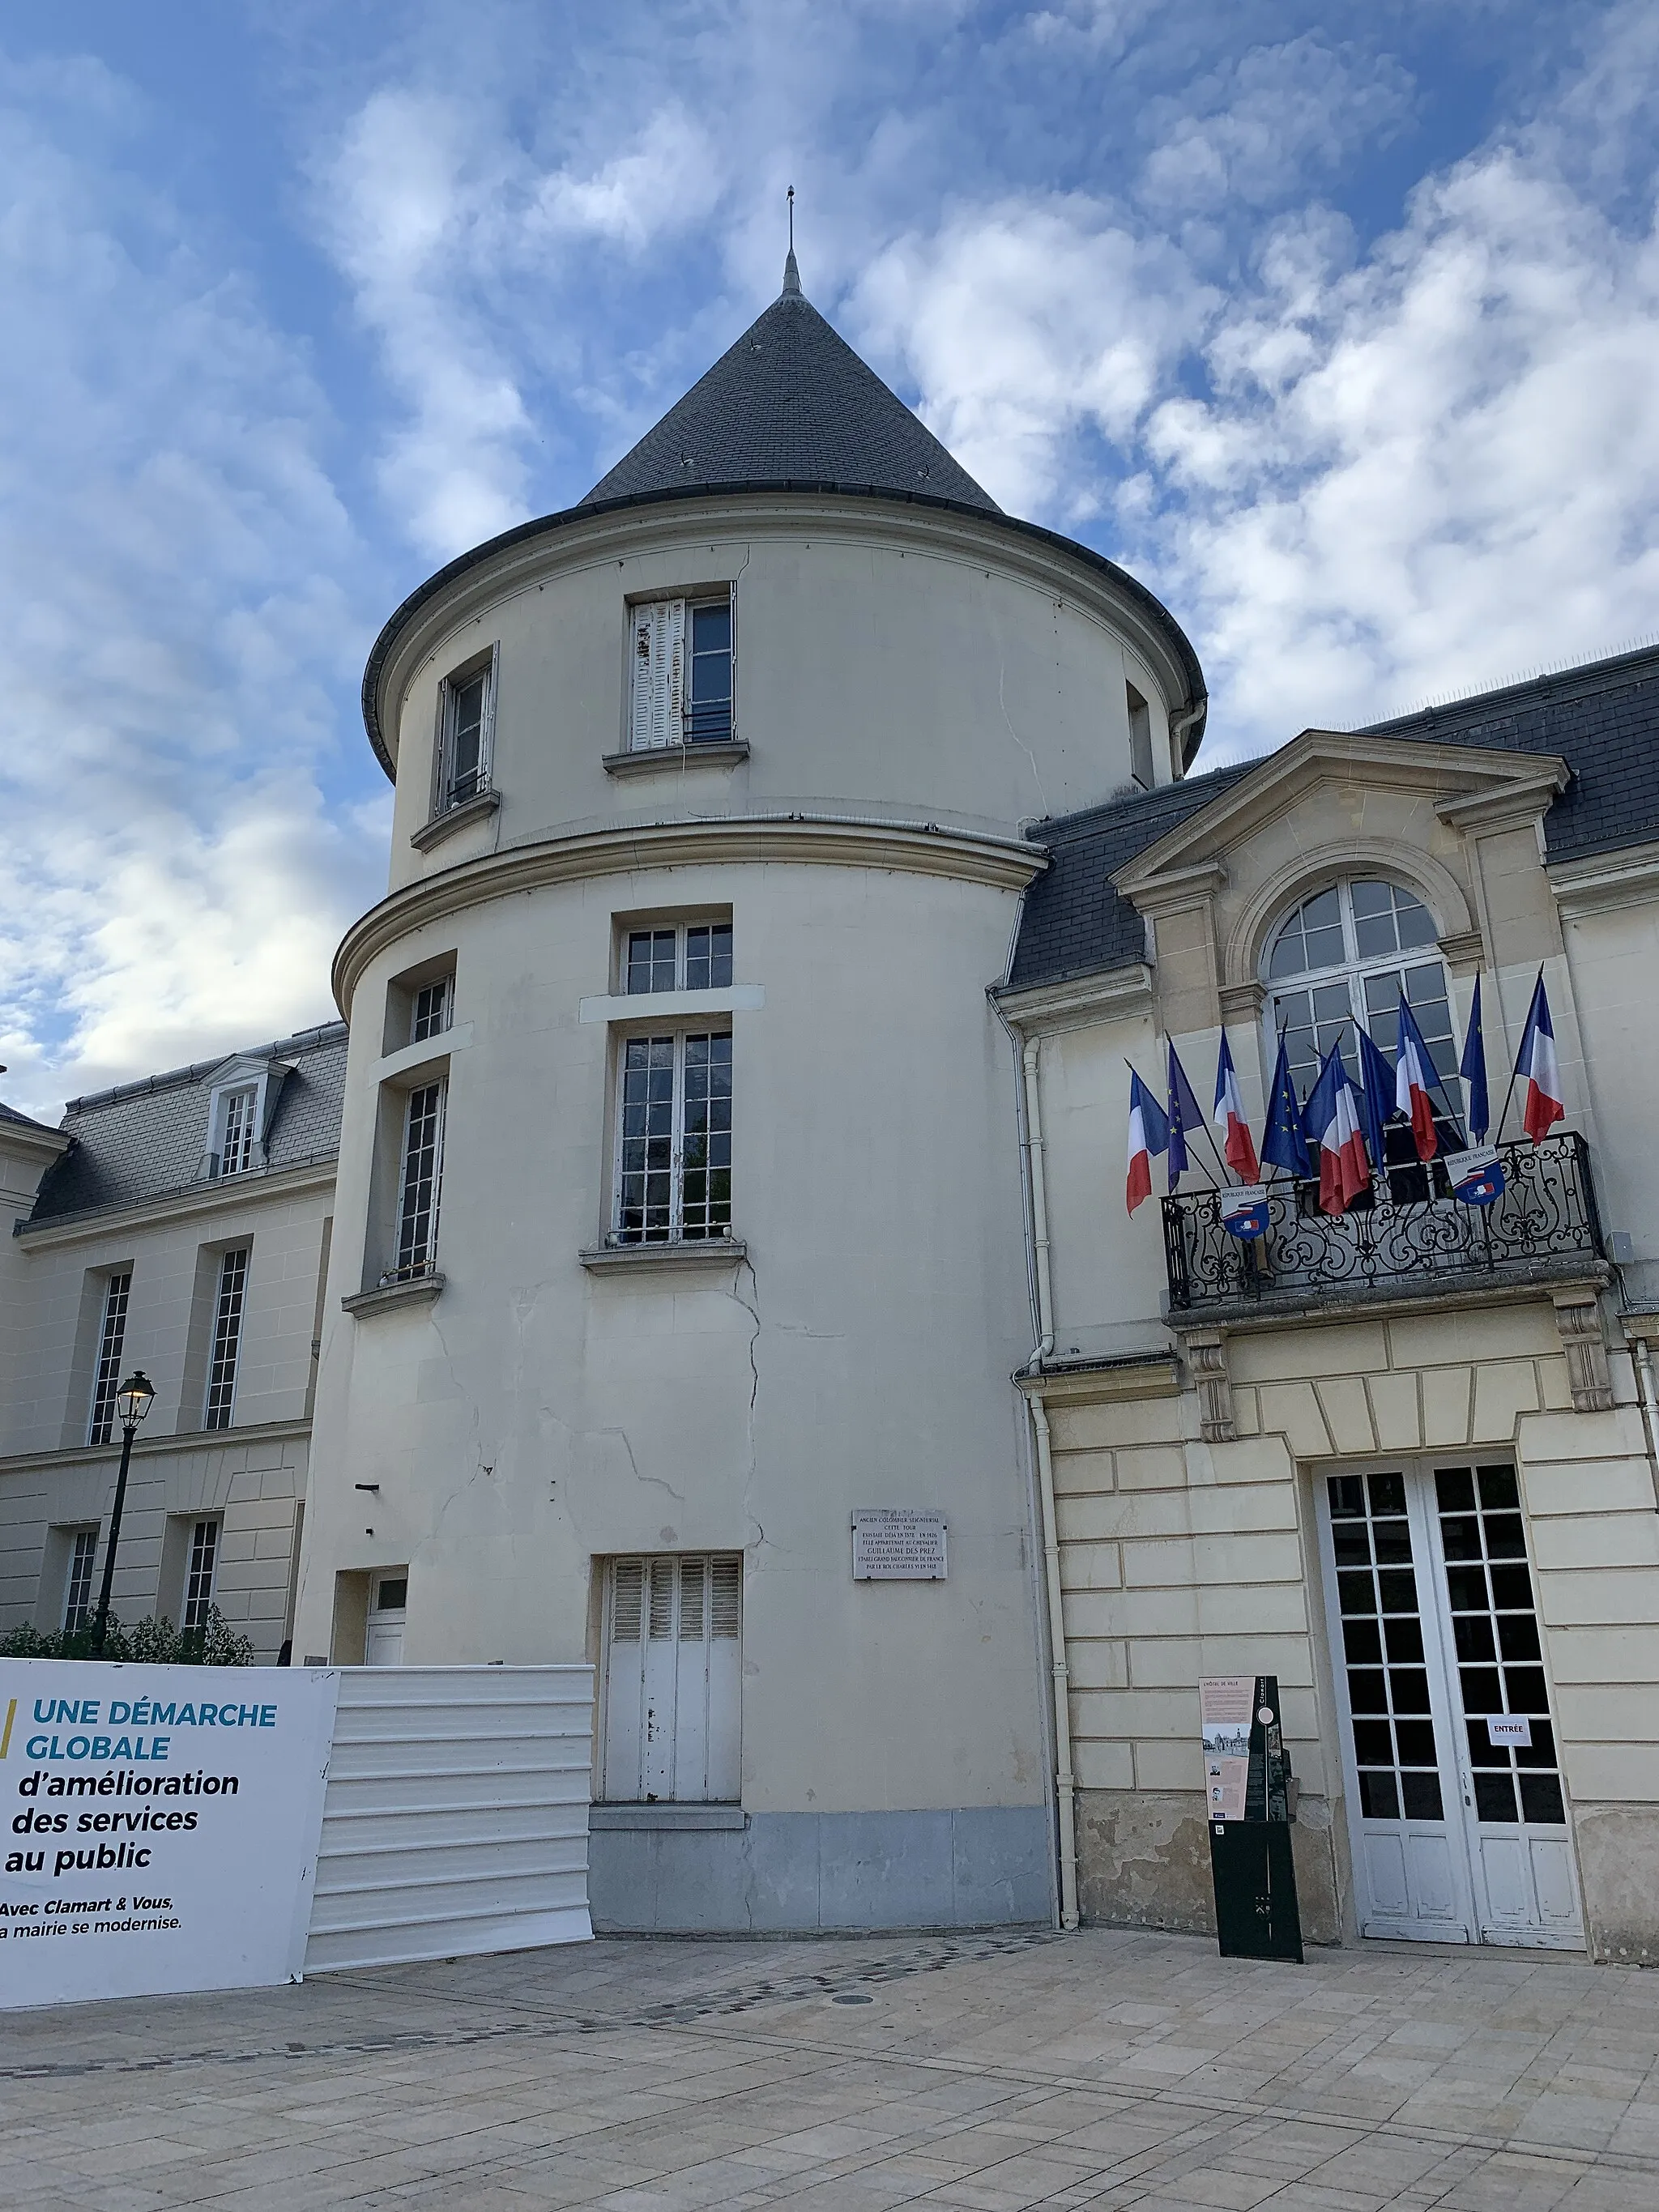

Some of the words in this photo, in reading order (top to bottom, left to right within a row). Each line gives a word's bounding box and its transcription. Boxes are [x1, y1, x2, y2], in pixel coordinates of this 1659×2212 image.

[1472, 1149, 1495, 1159] FRANÇAISE
[33, 1699, 100, 1724] UNE
[109, 1695, 278, 1727] DÉMARCHE
[1494, 1724, 1524, 1733] ENTRÉE
[26, 1736, 171, 1760] GLOBALE
[19, 1770, 239, 1796] d’amélioration
[12, 1808, 69, 1834] des
[76, 1805, 198, 1833] services
[5, 1852, 45, 1872] au
[53, 1842, 151, 1877] public
[0, 1903, 39, 1916] Avec
[44, 1899, 112, 1915] Clamart
[116, 1897, 126, 1911] &
[133, 1896, 173, 1911] Vous,
[13, 1920, 67, 1938] mairie
[71, 1922, 89, 1934] se
[94, 1916, 181, 1933] modernise.
